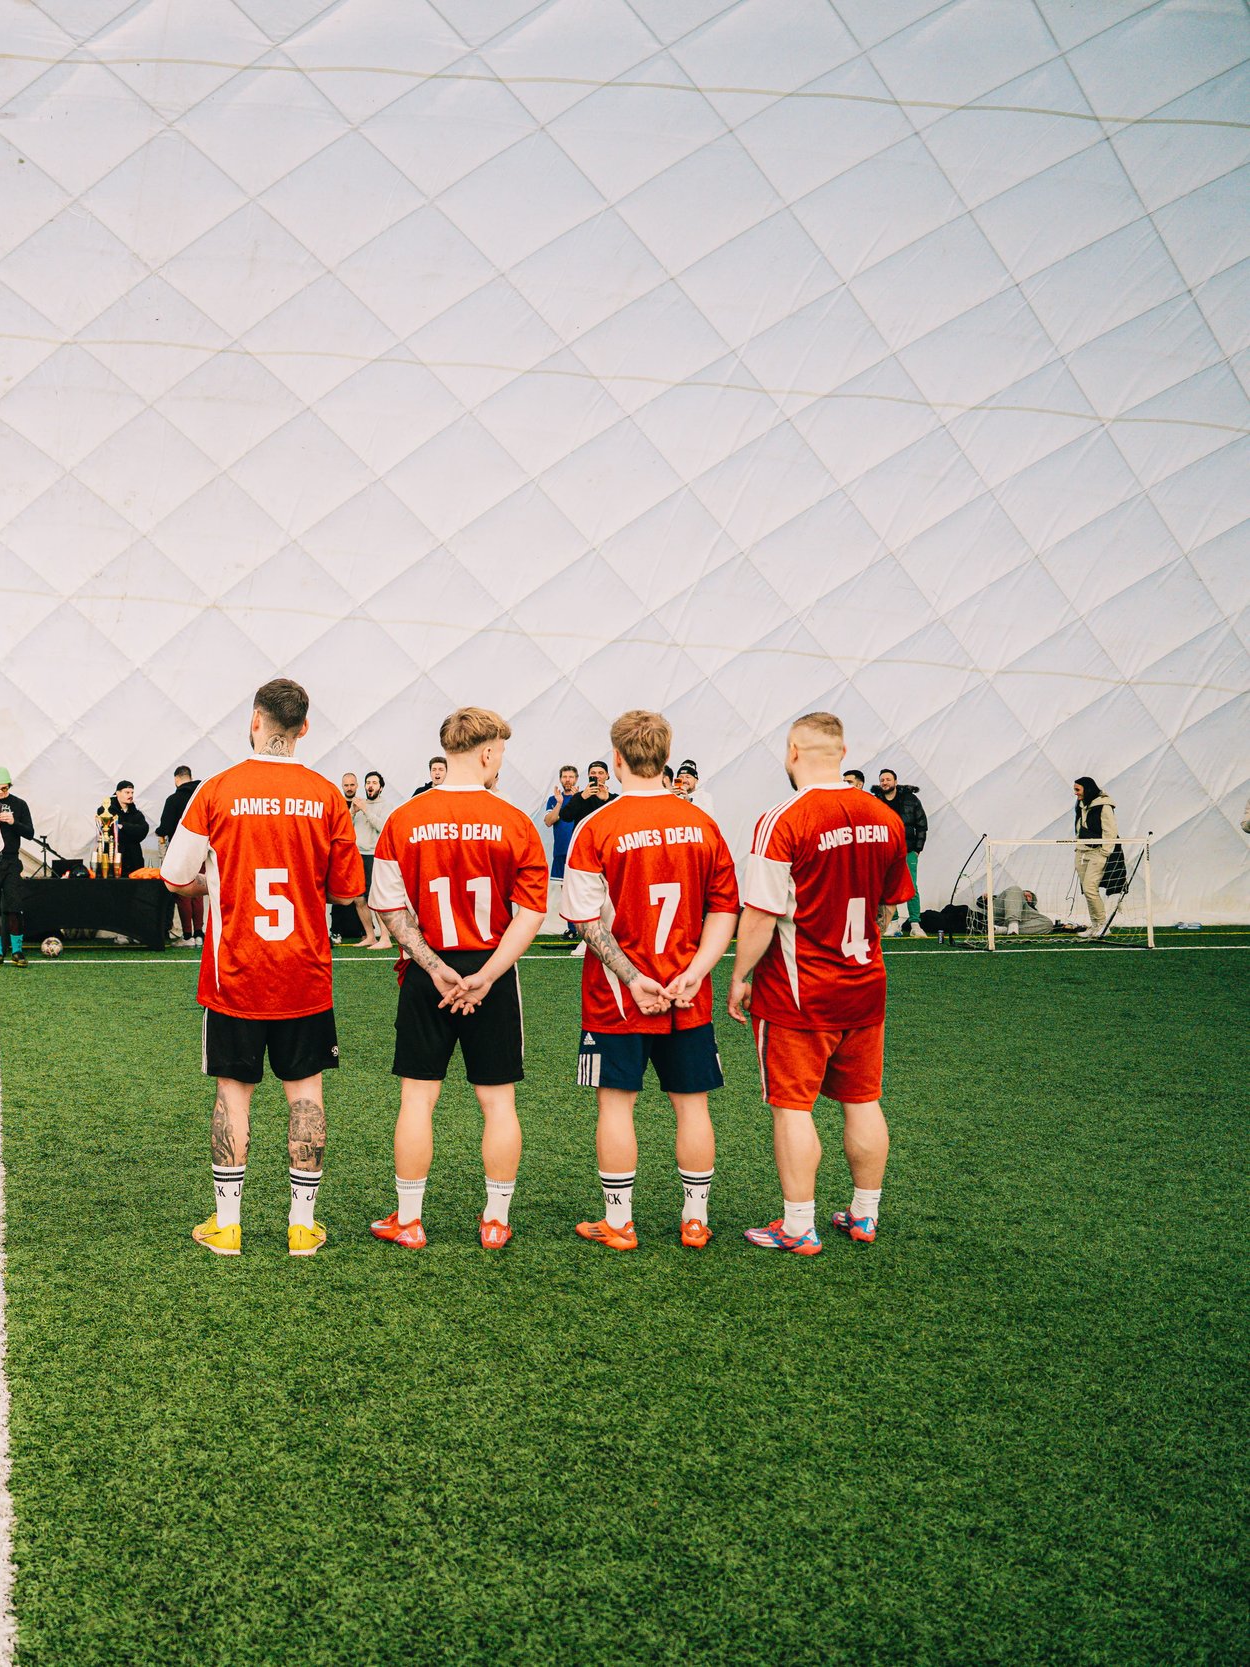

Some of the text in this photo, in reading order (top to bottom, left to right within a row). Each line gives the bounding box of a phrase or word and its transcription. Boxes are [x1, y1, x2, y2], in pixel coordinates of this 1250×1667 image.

[230, 797, 324, 819] JAMES DEAN
[409, 822, 503, 844] JAMES DEAN
[616, 826, 704, 854] JAMES DEAN
[855, 824, 889, 844] DEAN
[254, 867, 295, 942] 5
[428, 876, 494, 951] 11
[648, 882, 681, 956] 7
[840, 897, 872, 966] 4
